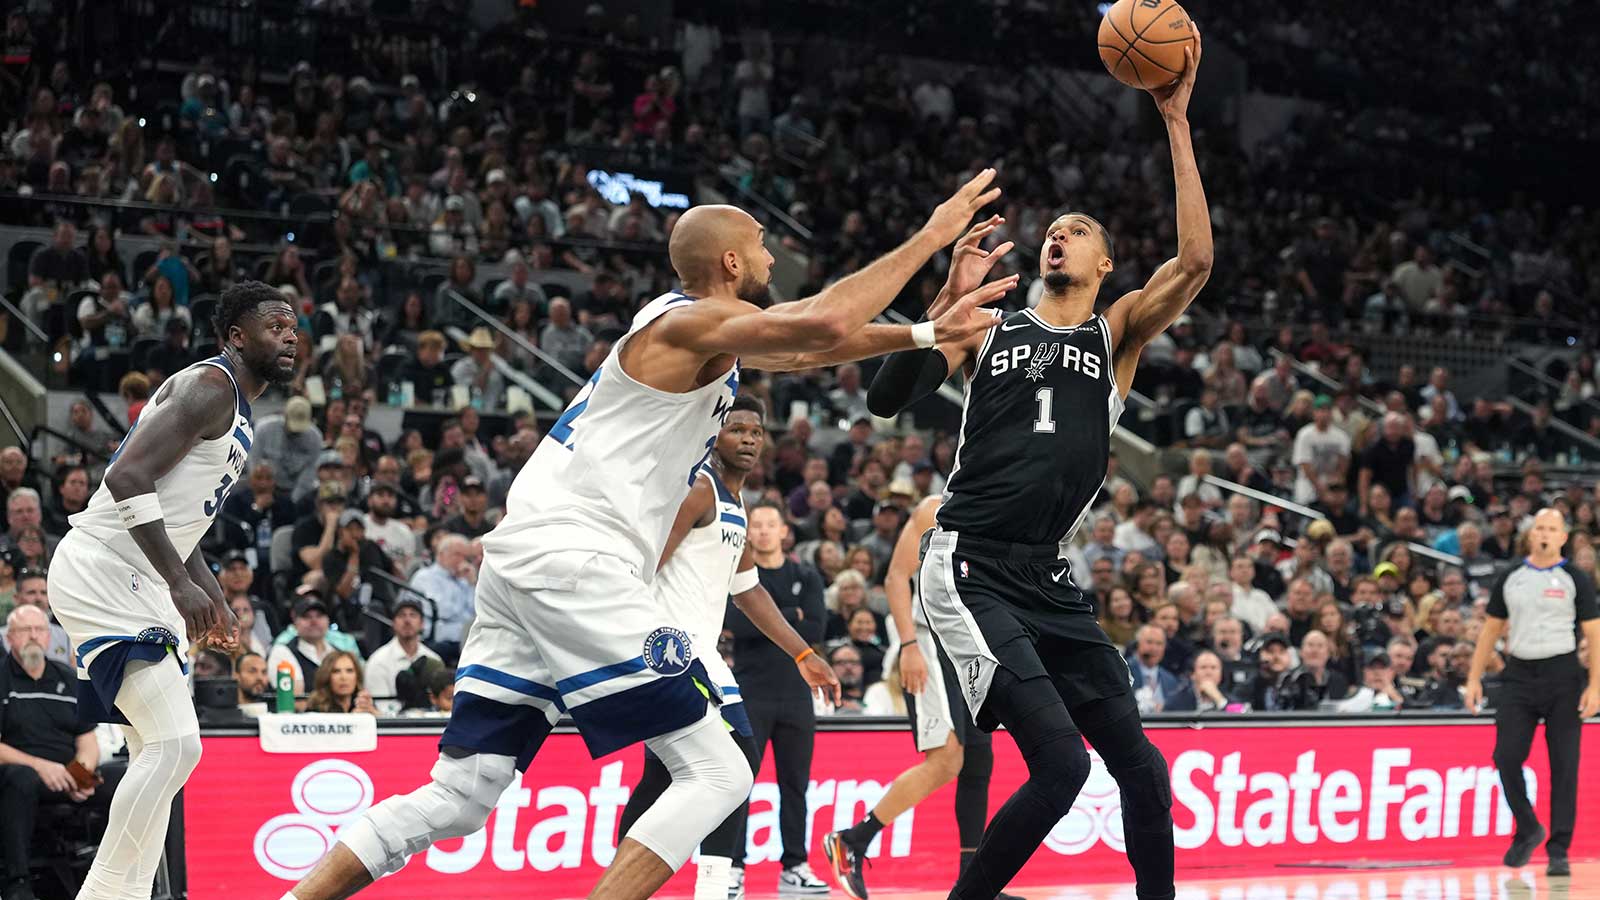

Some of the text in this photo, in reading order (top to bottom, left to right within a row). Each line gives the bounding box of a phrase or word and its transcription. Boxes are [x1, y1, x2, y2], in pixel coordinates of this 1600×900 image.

[991, 342, 1101, 381] SPURS
[1033, 387, 1056, 433] 1
[281, 724, 353, 735] GATORADE
[743, 778, 915, 865] arm
[1171, 749, 1363, 849] State
